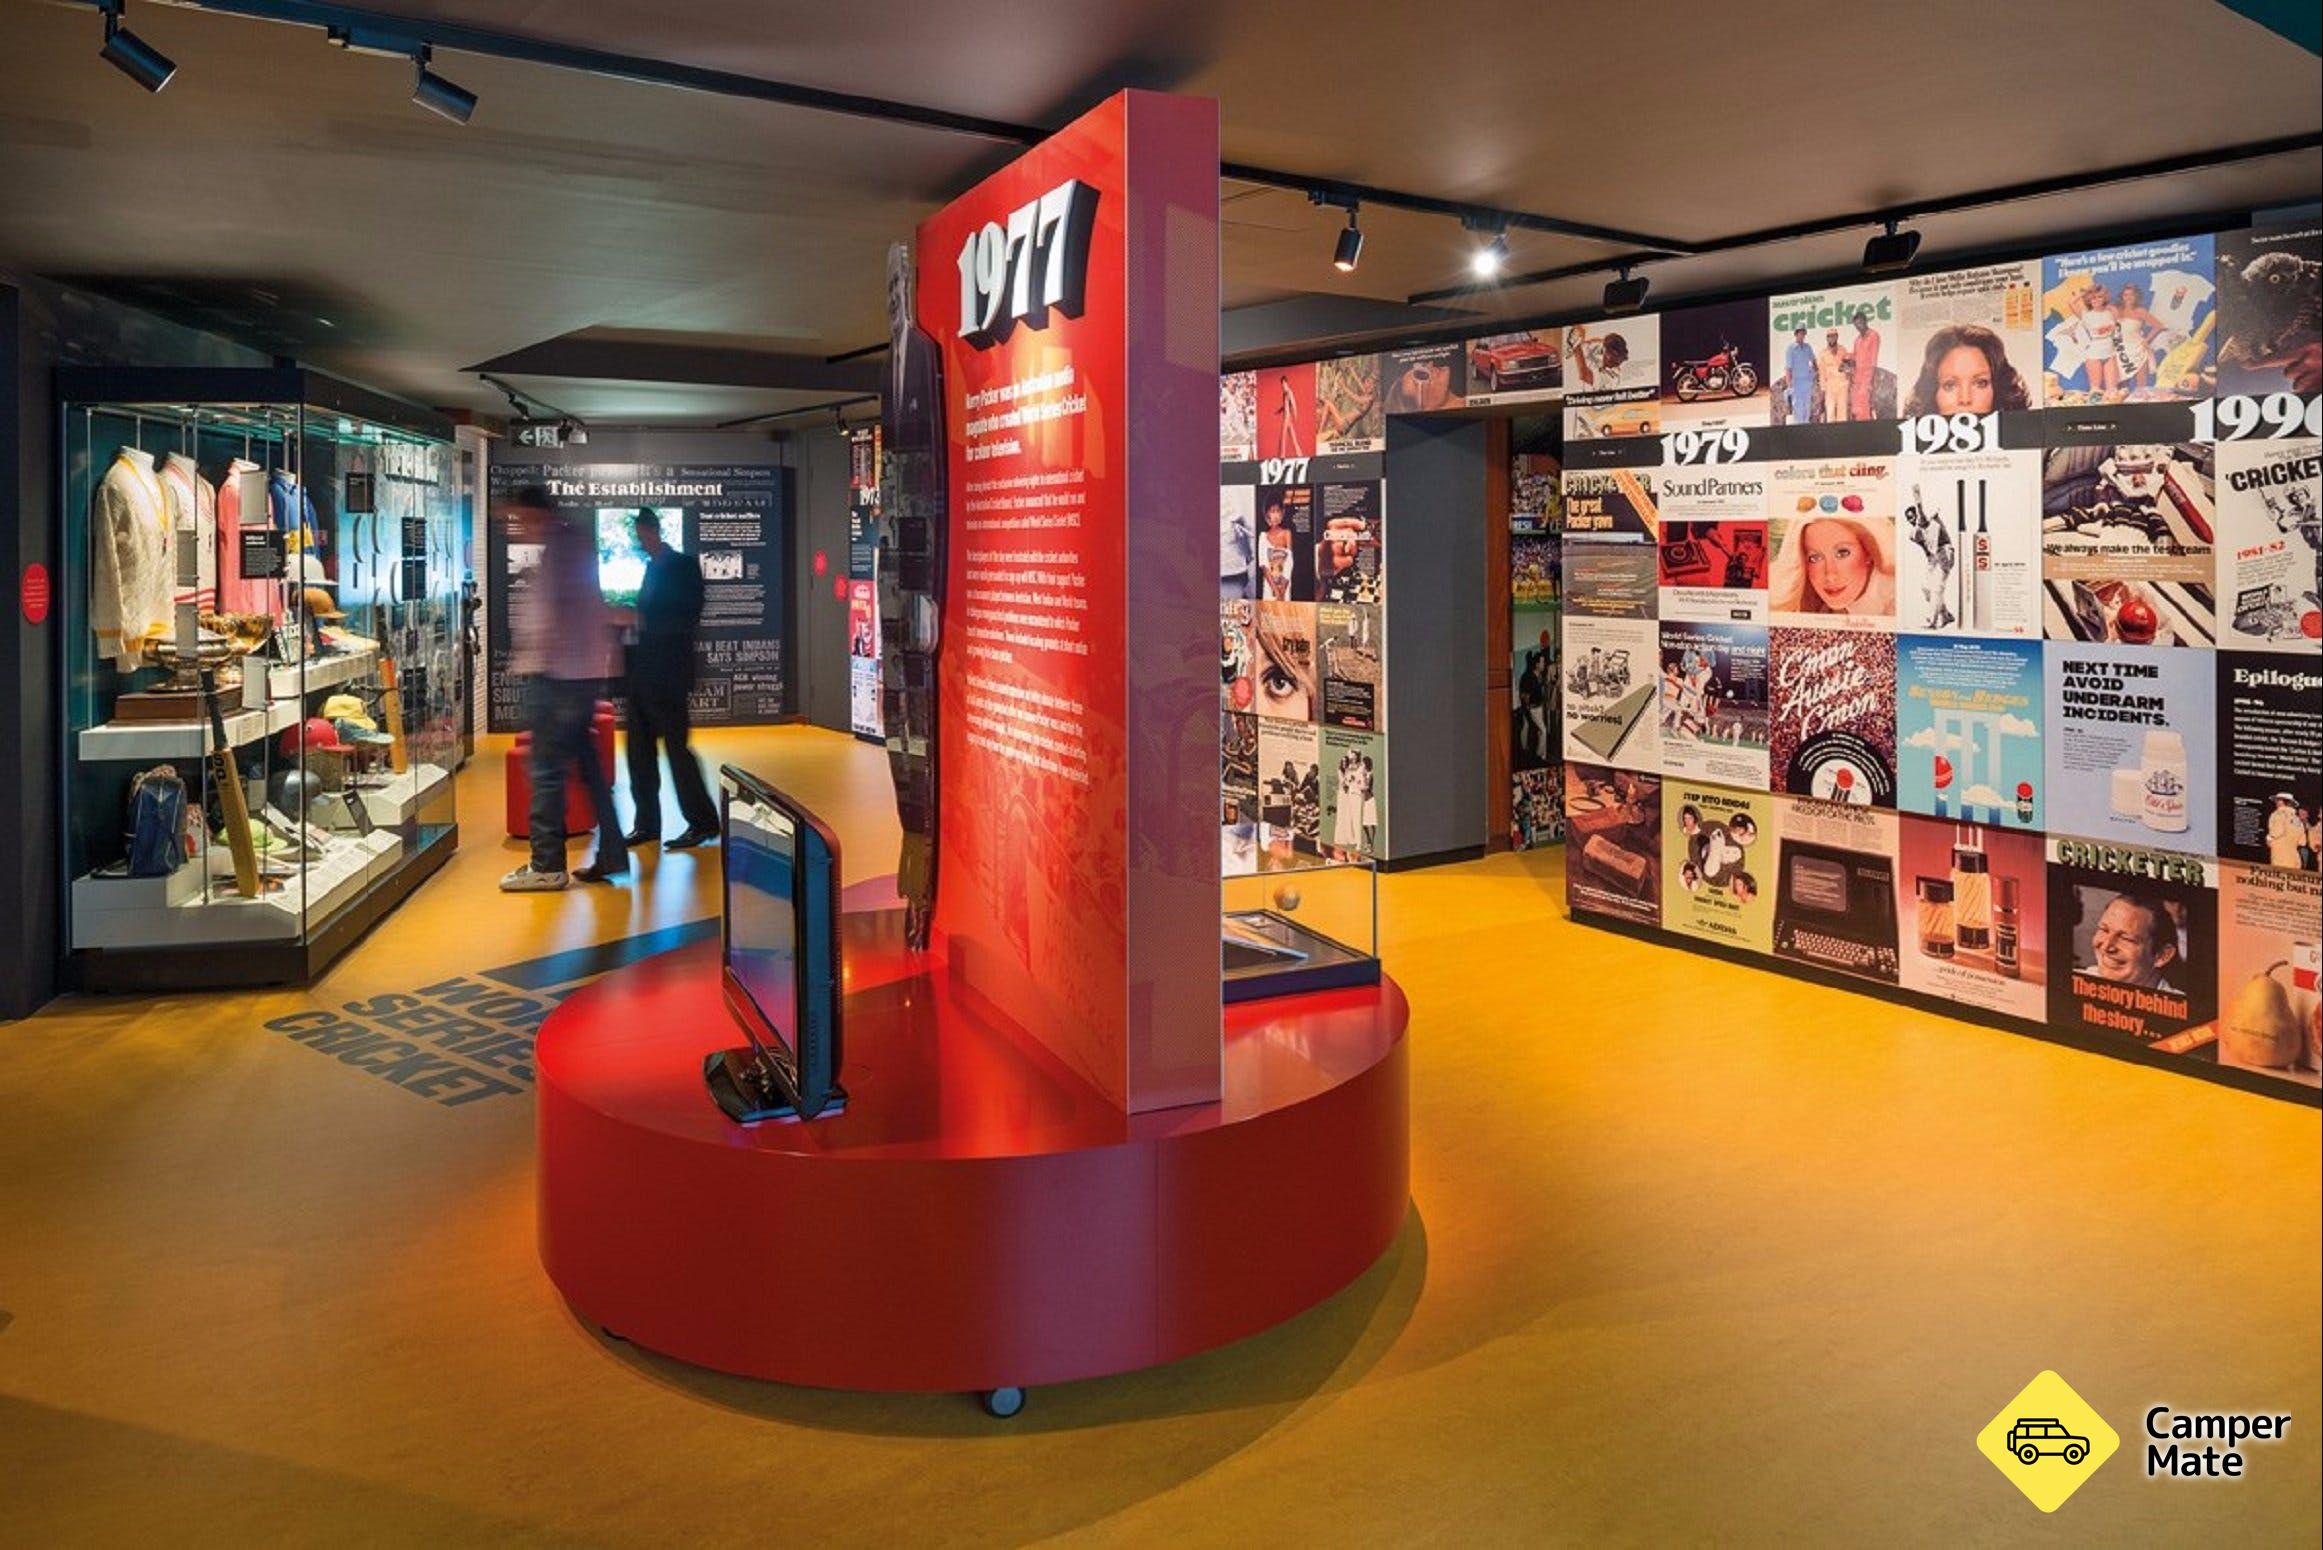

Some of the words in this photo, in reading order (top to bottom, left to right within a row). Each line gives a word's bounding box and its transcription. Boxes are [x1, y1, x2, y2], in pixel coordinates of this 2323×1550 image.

[957, 179, 1077, 337] 1977
[1773, 296, 1892, 332] cricket
[1063, 394, 1087, 417] Cricket
[1898, 411, 2000, 455] 1981
[1660, 427, 1750, 468] 1979
[1260, 457, 1311, 486] 1977
[2225, 455, 2322, 492] 'CRICKE
[545, 479, 585, 496] The
[588, 480, 723, 497] Establishment
[2064, 544, 2099, 555] always
[2101, 544, 2130, 554] make
[2132, 544, 2152, 554] the
[2063, 660, 2108, 676] NEXT
[2113, 663, 2159, 678] TIME
[2063, 675, 2124, 691] AVOID
[2062, 690, 2165, 711] UNDERARM
[2062, 706, 2171, 727] INCIDENTS.
[2055, 839, 2205, 888] CRICKETER
[2286, 880, 2307, 895] but
[2072, 975, 2098, 998] The
[2098, 982, 2134, 1010] story
[2135, 990, 2188, 1020] behind
[2083, 1002, 2107, 1026] the
[263, 1010, 525, 1107] CRICKET
